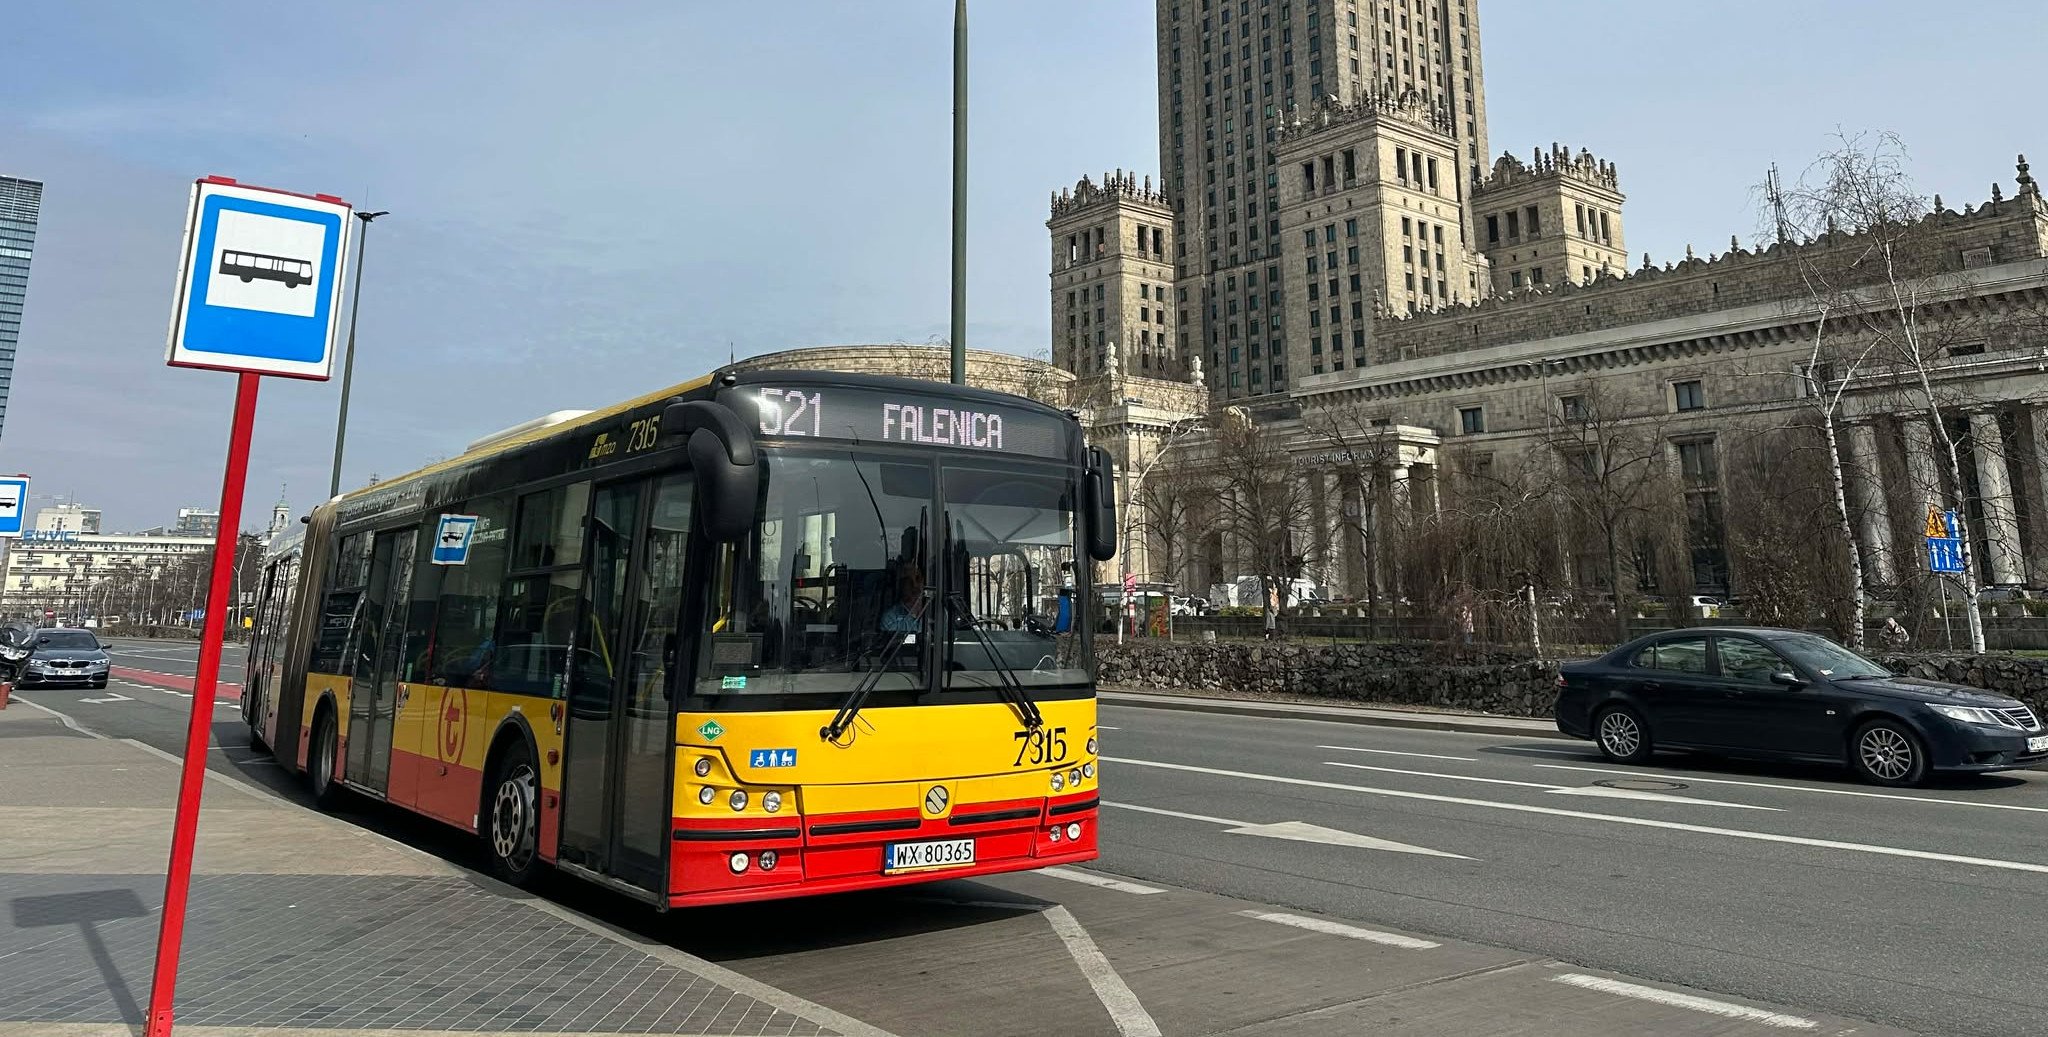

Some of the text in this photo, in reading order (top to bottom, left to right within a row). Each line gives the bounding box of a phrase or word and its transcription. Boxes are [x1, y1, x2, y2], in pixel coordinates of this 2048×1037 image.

[626, 415, 660, 453] 7315
[759, 387, 1002, 449] 521 FALENICA
[702, 726, 720, 735] LNG
[1013, 727, 1067, 767] 7315
[897, 845, 920, 866] WX
[925, 842, 972, 863] 80365
